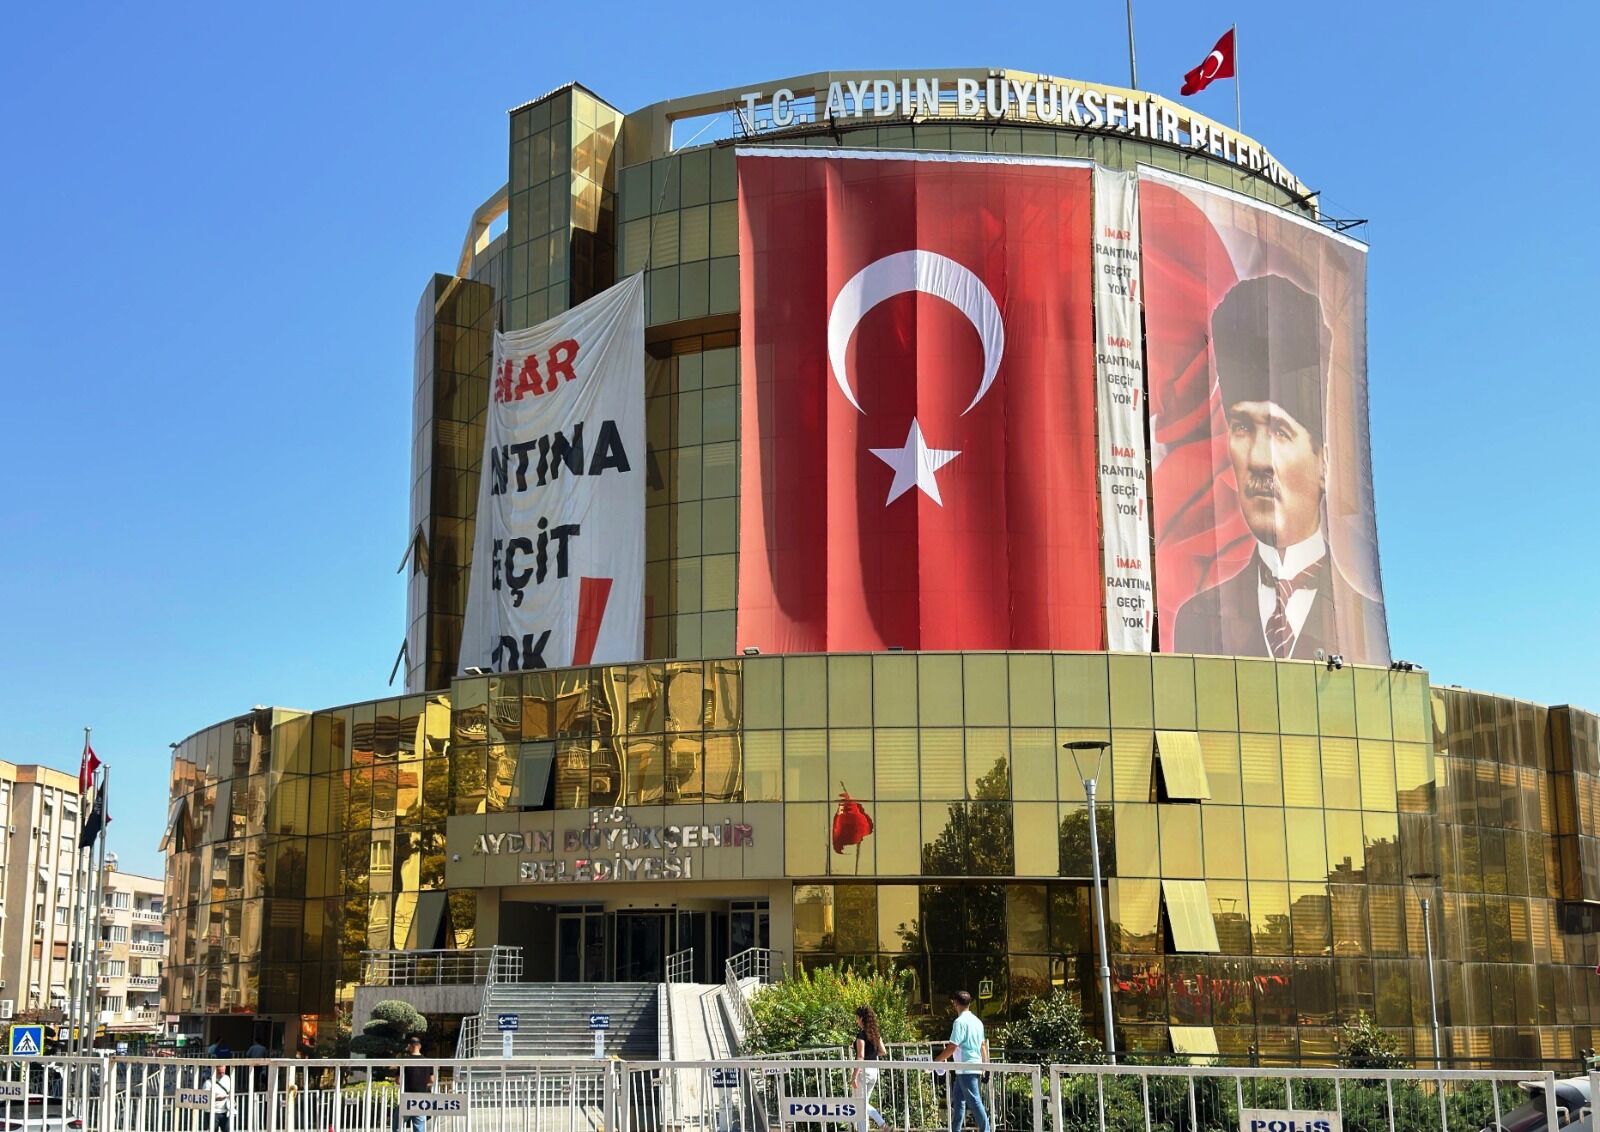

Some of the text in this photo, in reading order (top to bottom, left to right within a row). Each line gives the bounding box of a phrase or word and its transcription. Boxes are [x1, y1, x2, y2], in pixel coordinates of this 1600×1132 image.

[741, 88, 807, 132] T.C.
[823, 78, 940, 120] AYDIN
[1104, 225, 1131, 241] İMAR
[1095, 243, 1138, 261] RANTINA
[1103, 264, 1132, 280] GEÇİT
[1107, 334, 1132, 349] İMAR
[1098, 353, 1141, 370] RANTINA
[1107, 374, 1134, 389] GEÇİT
[1111, 444, 1136, 458] İMAR
[1102, 465, 1145, 481] RANTINA
[1116, 555, 1142, 570] İMAR
[1107, 576, 1151, 592] RANTINA
[1116, 595, 1146, 613] GEÇİT
[472, 817, 754, 855] AYDIN BÜYÜKŞEHİR
[520, 852, 692, 882] BELEDİYESİ
